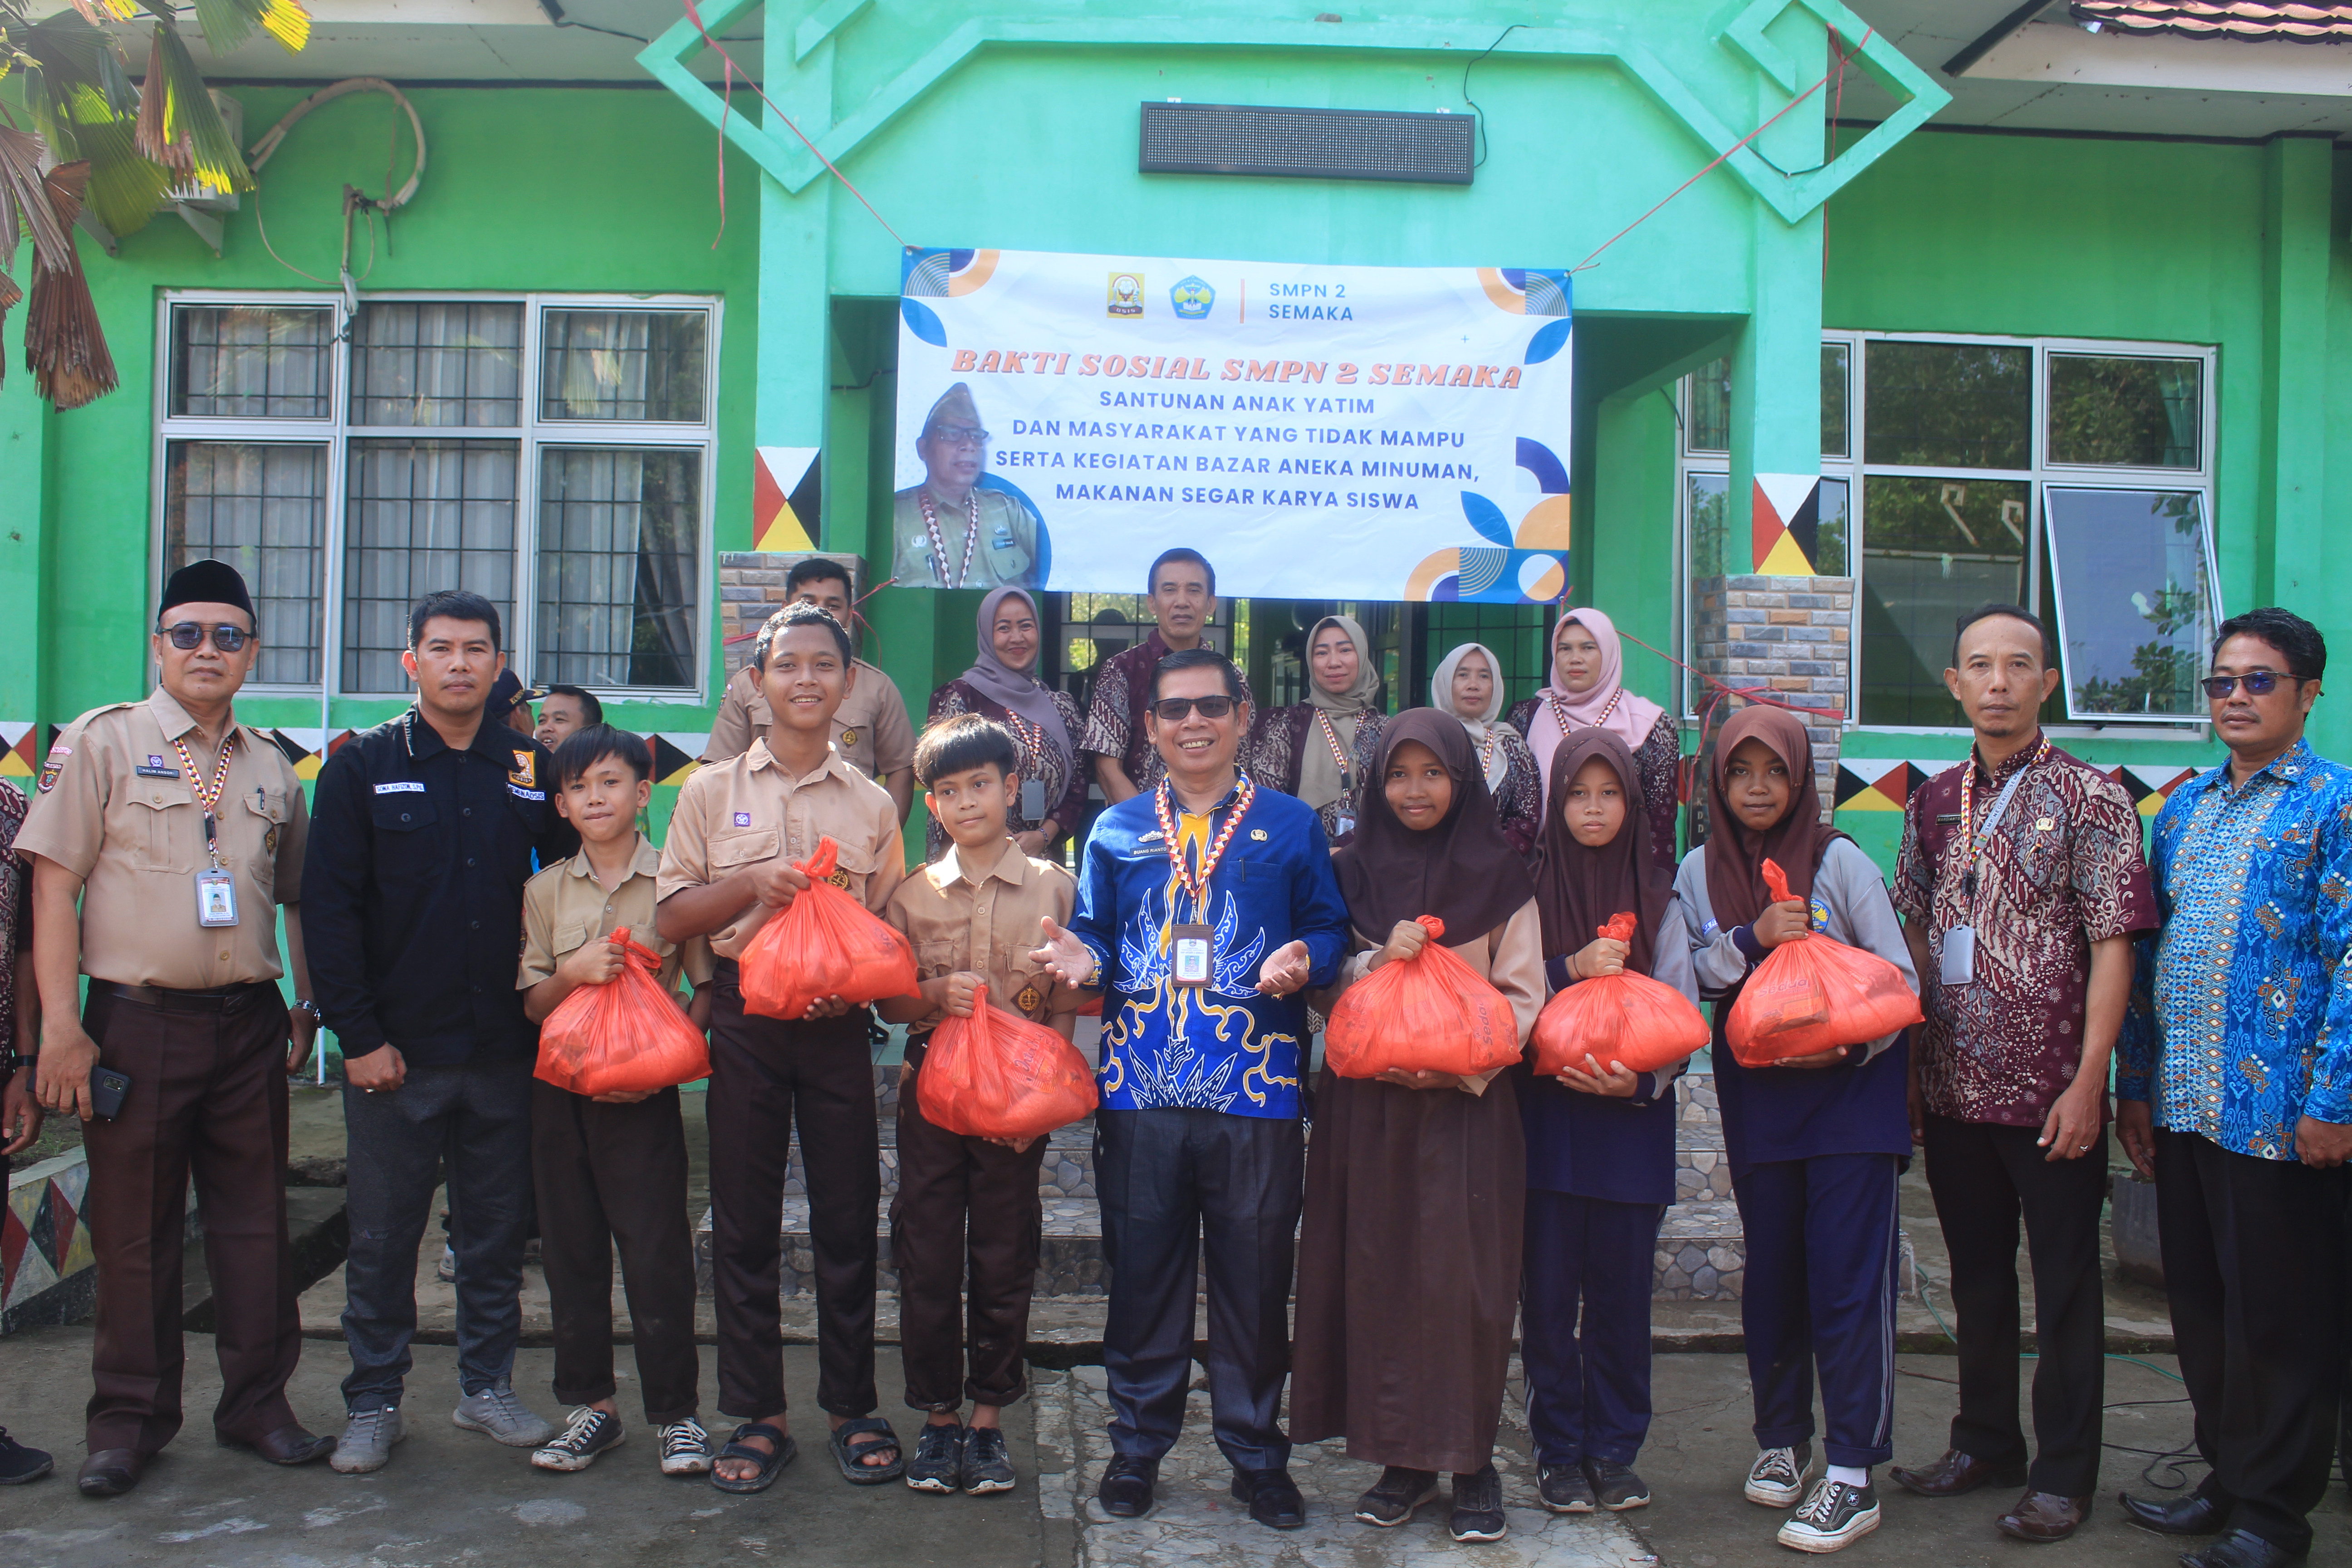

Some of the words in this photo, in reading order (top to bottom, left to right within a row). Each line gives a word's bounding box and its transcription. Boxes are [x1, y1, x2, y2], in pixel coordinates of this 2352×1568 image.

[1269, 283, 1327, 298] SMPN
[1335, 284, 1346, 298] 2
[1269, 304, 1353, 321] SEMAKA
[951, 349, 1069, 375] BAKTI
[1077, 354, 1210, 380] SOSIAL
[1220, 359, 1330, 385] SMPN
[1336, 363, 1360, 385] 2
[1368, 364, 1523, 389] SEMAKA
[1099, 391, 1225, 410] SANTUNAN
[1232, 395, 1296, 412] ANAK
[1303, 397, 1375, 414] YATIM
[1013, 419, 1061, 436] DAN
[1068, 421, 1227, 441] MASYARAKAT
[1233, 426, 1298, 443] YANG
[1305, 428, 1373, 445] TIDAK
[1380, 430, 1465, 448] MAMPU
[995, 450, 1066, 468] SERTA
[1073, 452, 1188, 471] KEGIATAN
[1196, 456, 1271, 474] BAZAR
[1277, 458, 1354, 476] ANEKA
[1362, 461, 1480, 482] MINUMAN,
[1056, 484, 1174, 503] MAKANAN
[1181, 487, 1255, 505] SEGAR
[1263, 489, 1339, 507] KARYA
[1347, 492, 1419, 510] SISWA
[1984, 818, 1994, 831] SMP
[1992, 795, 2008, 818] NEGERI
[2009, 768, 2024, 788] SEMA
